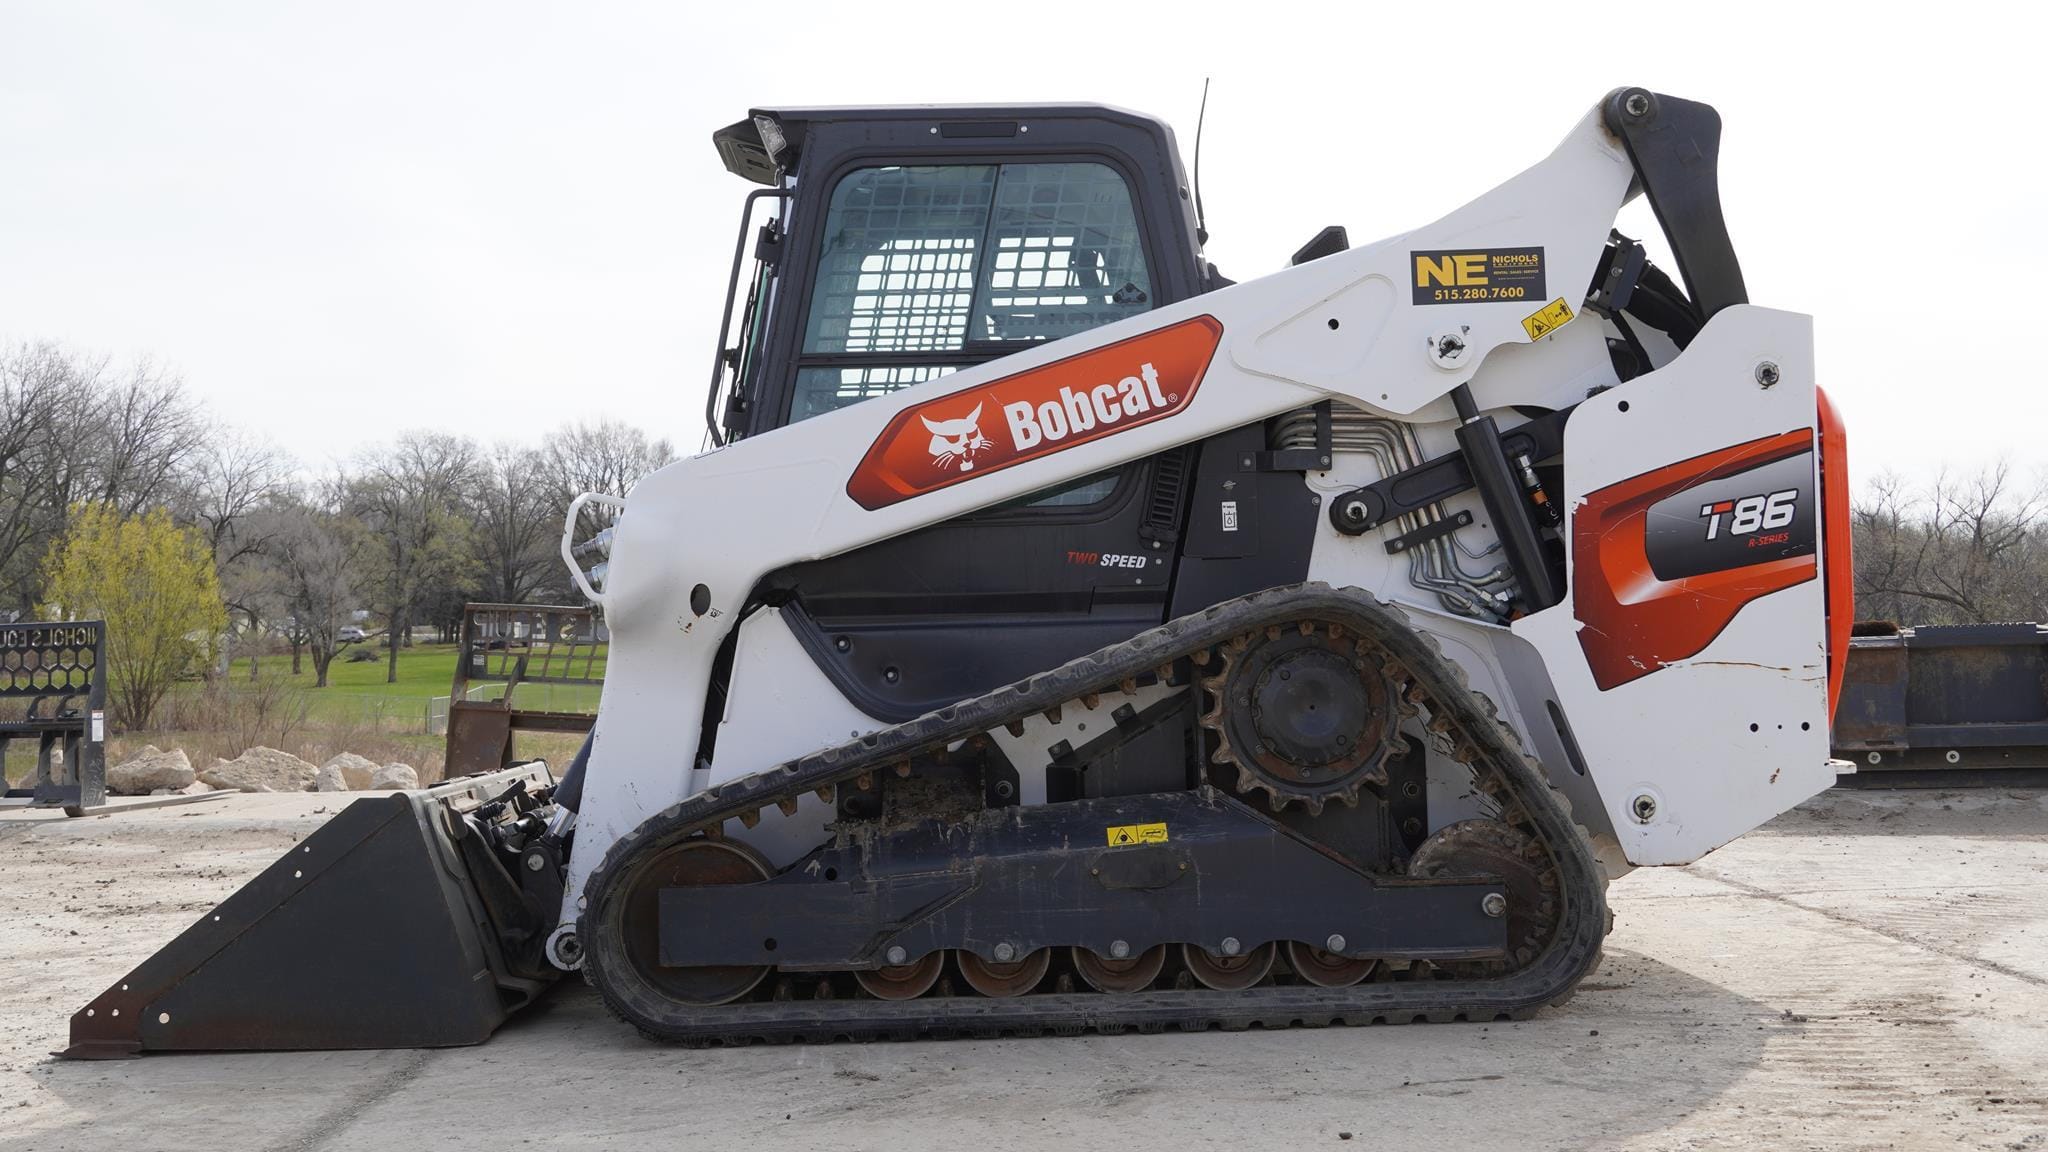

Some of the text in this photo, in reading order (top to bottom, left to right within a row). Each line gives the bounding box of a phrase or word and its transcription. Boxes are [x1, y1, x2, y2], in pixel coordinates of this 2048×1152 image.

[1492, 254, 1538, 263] NICHOLS
[1416, 254, 1489, 288] NE
[1434, 287, 1524, 301] 515.280.7600
[1004, 362, 1168, 451] Bobcat
[1701, 489, 1798, 540] T86
[1748, 533, 1789, 547] R-SERIES
[1066, 551, 1147, 569] TWO SPEED
